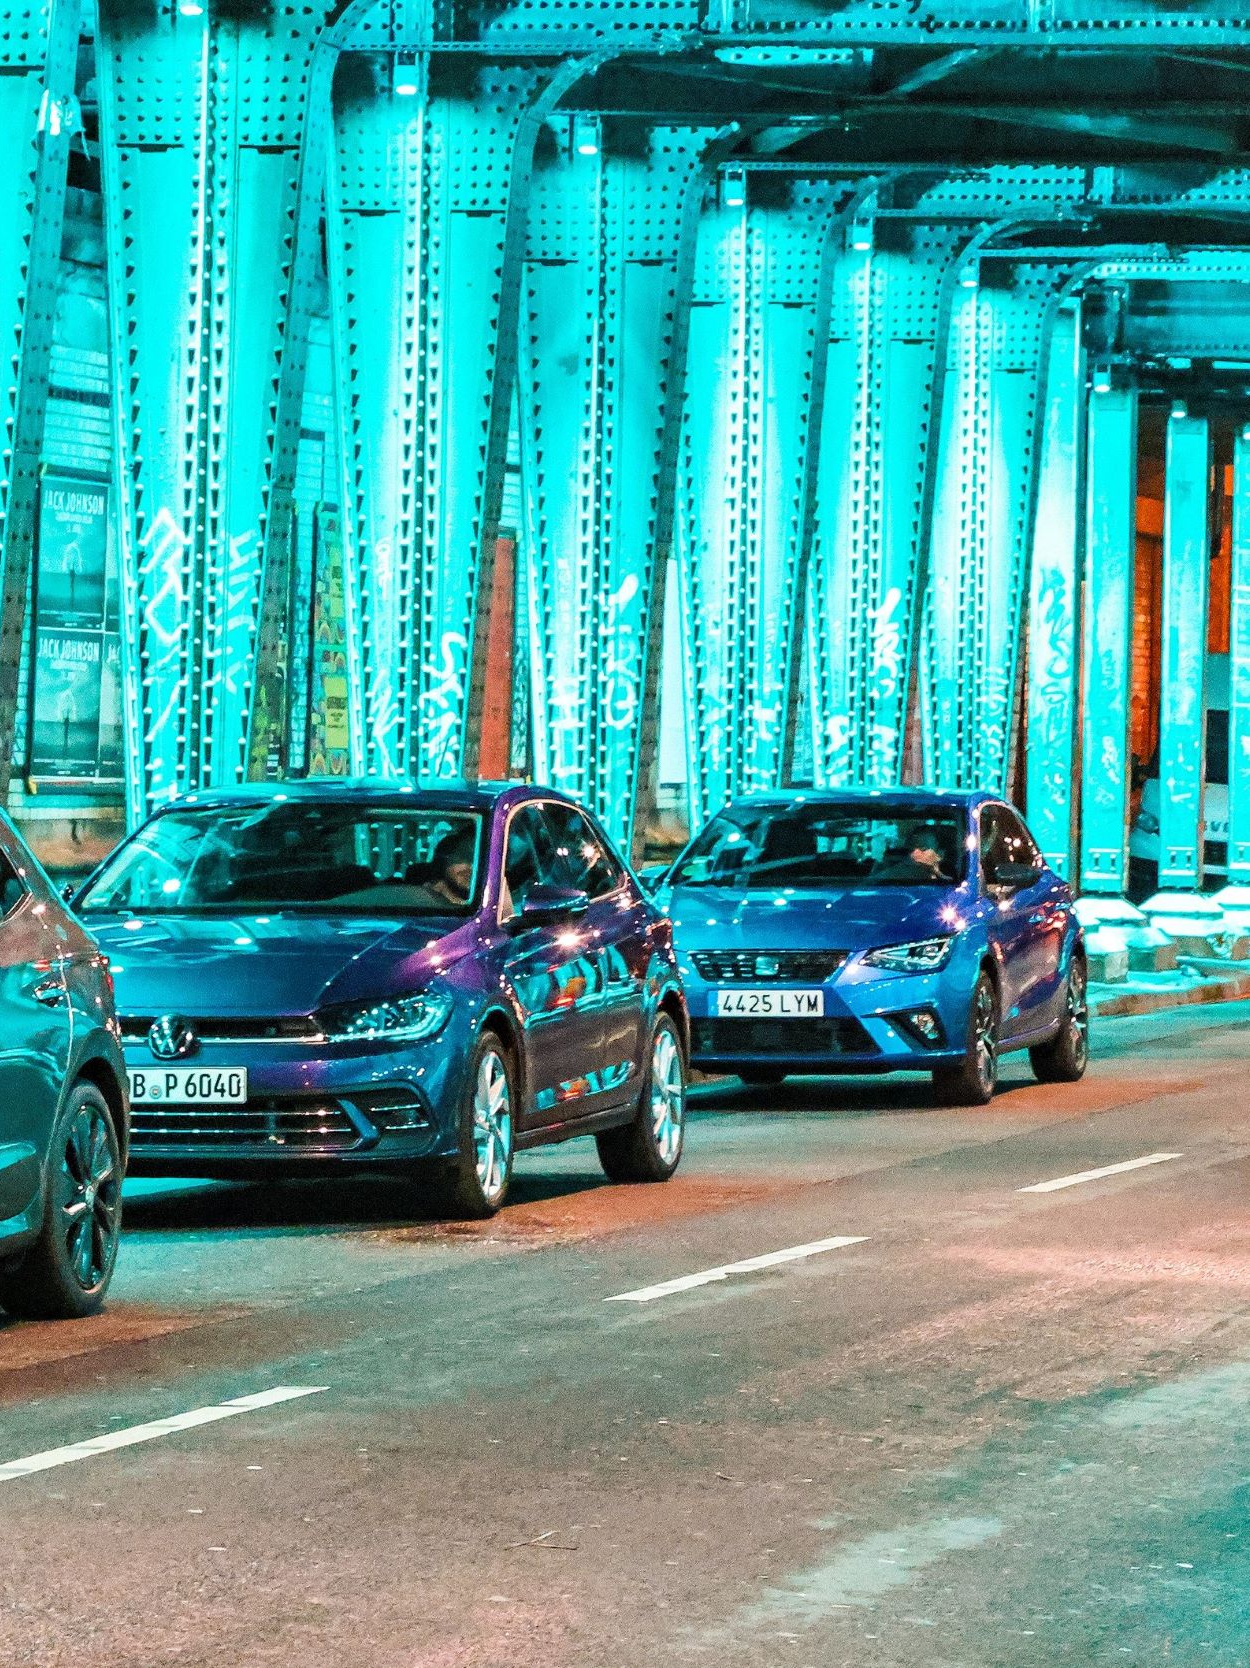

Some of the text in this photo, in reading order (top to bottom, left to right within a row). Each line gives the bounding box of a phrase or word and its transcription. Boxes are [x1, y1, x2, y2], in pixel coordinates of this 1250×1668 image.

[42, 489, 105, 516] JACK JOHNSON
[38, 637, 100, 662] JACK JOHNSON
[722, 993, 819, 1013] 4425 LYM
[129, 1073, 242, 1098] B P 6040
